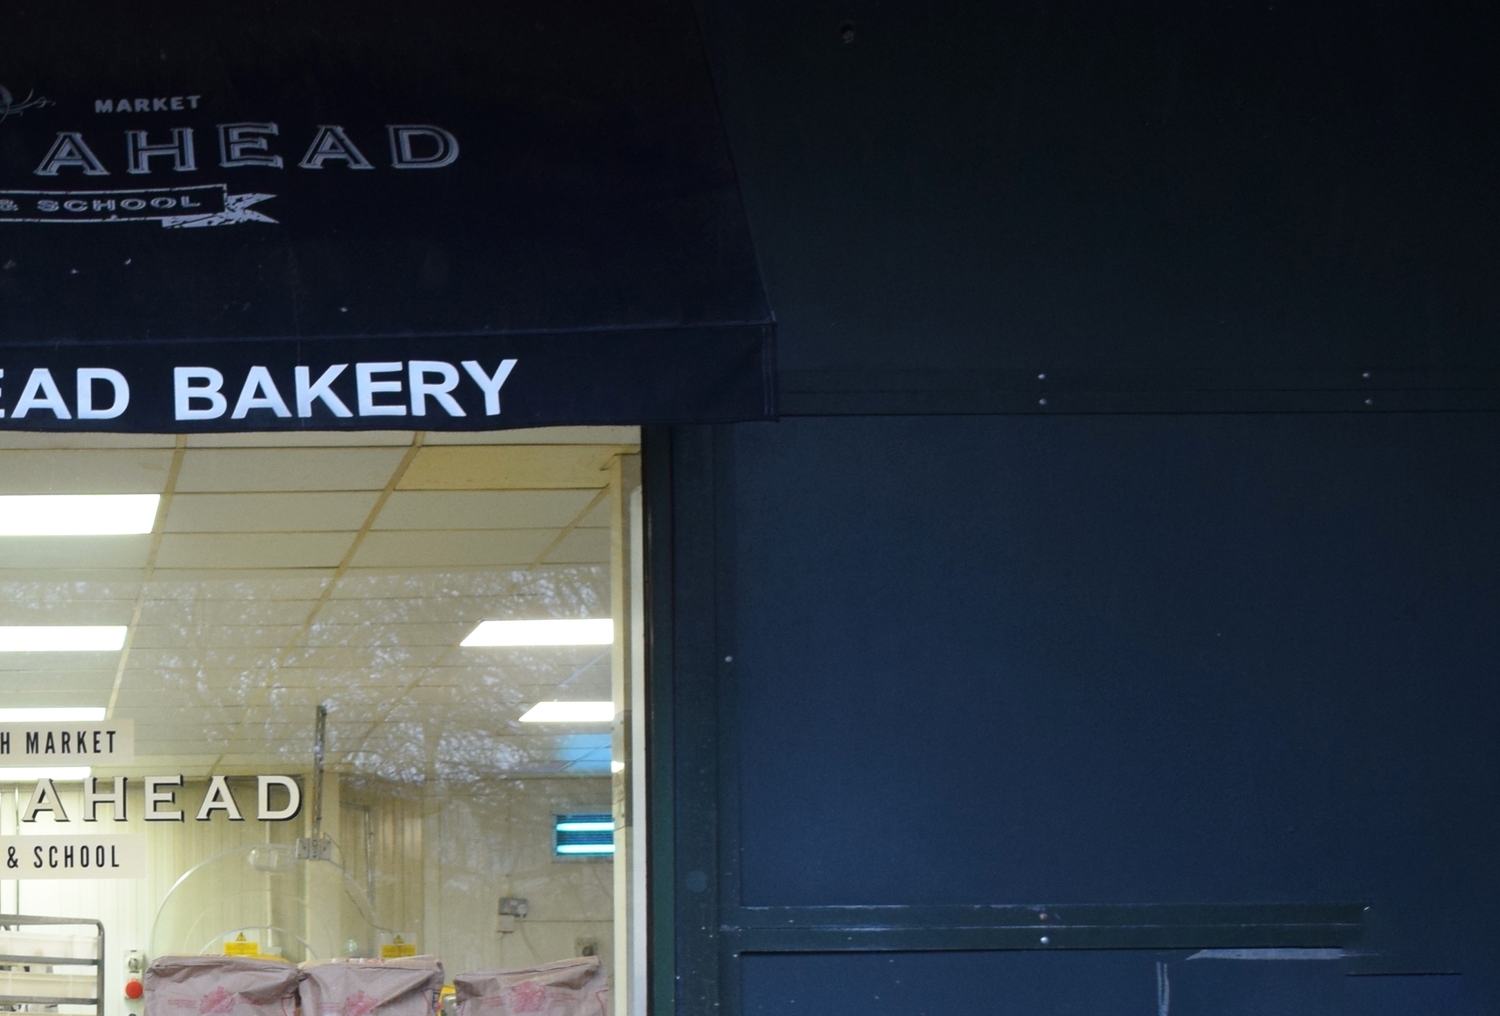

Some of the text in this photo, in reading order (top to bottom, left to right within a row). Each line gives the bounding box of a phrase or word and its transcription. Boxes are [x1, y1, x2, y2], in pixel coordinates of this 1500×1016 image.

[95, 95, 201, 113] MARKET
[33, 122, 460, 176] AHEAD
[37, 195, 201, 212] SCHOOL
[173, 359, 518, 421] BAKERY
[26, 731, 116, 754] MARKET
[21, 774, 302, 822] AHEAD
[6, 846, 19, 869] &
[33, 845, 119, 869] SCHOOL
